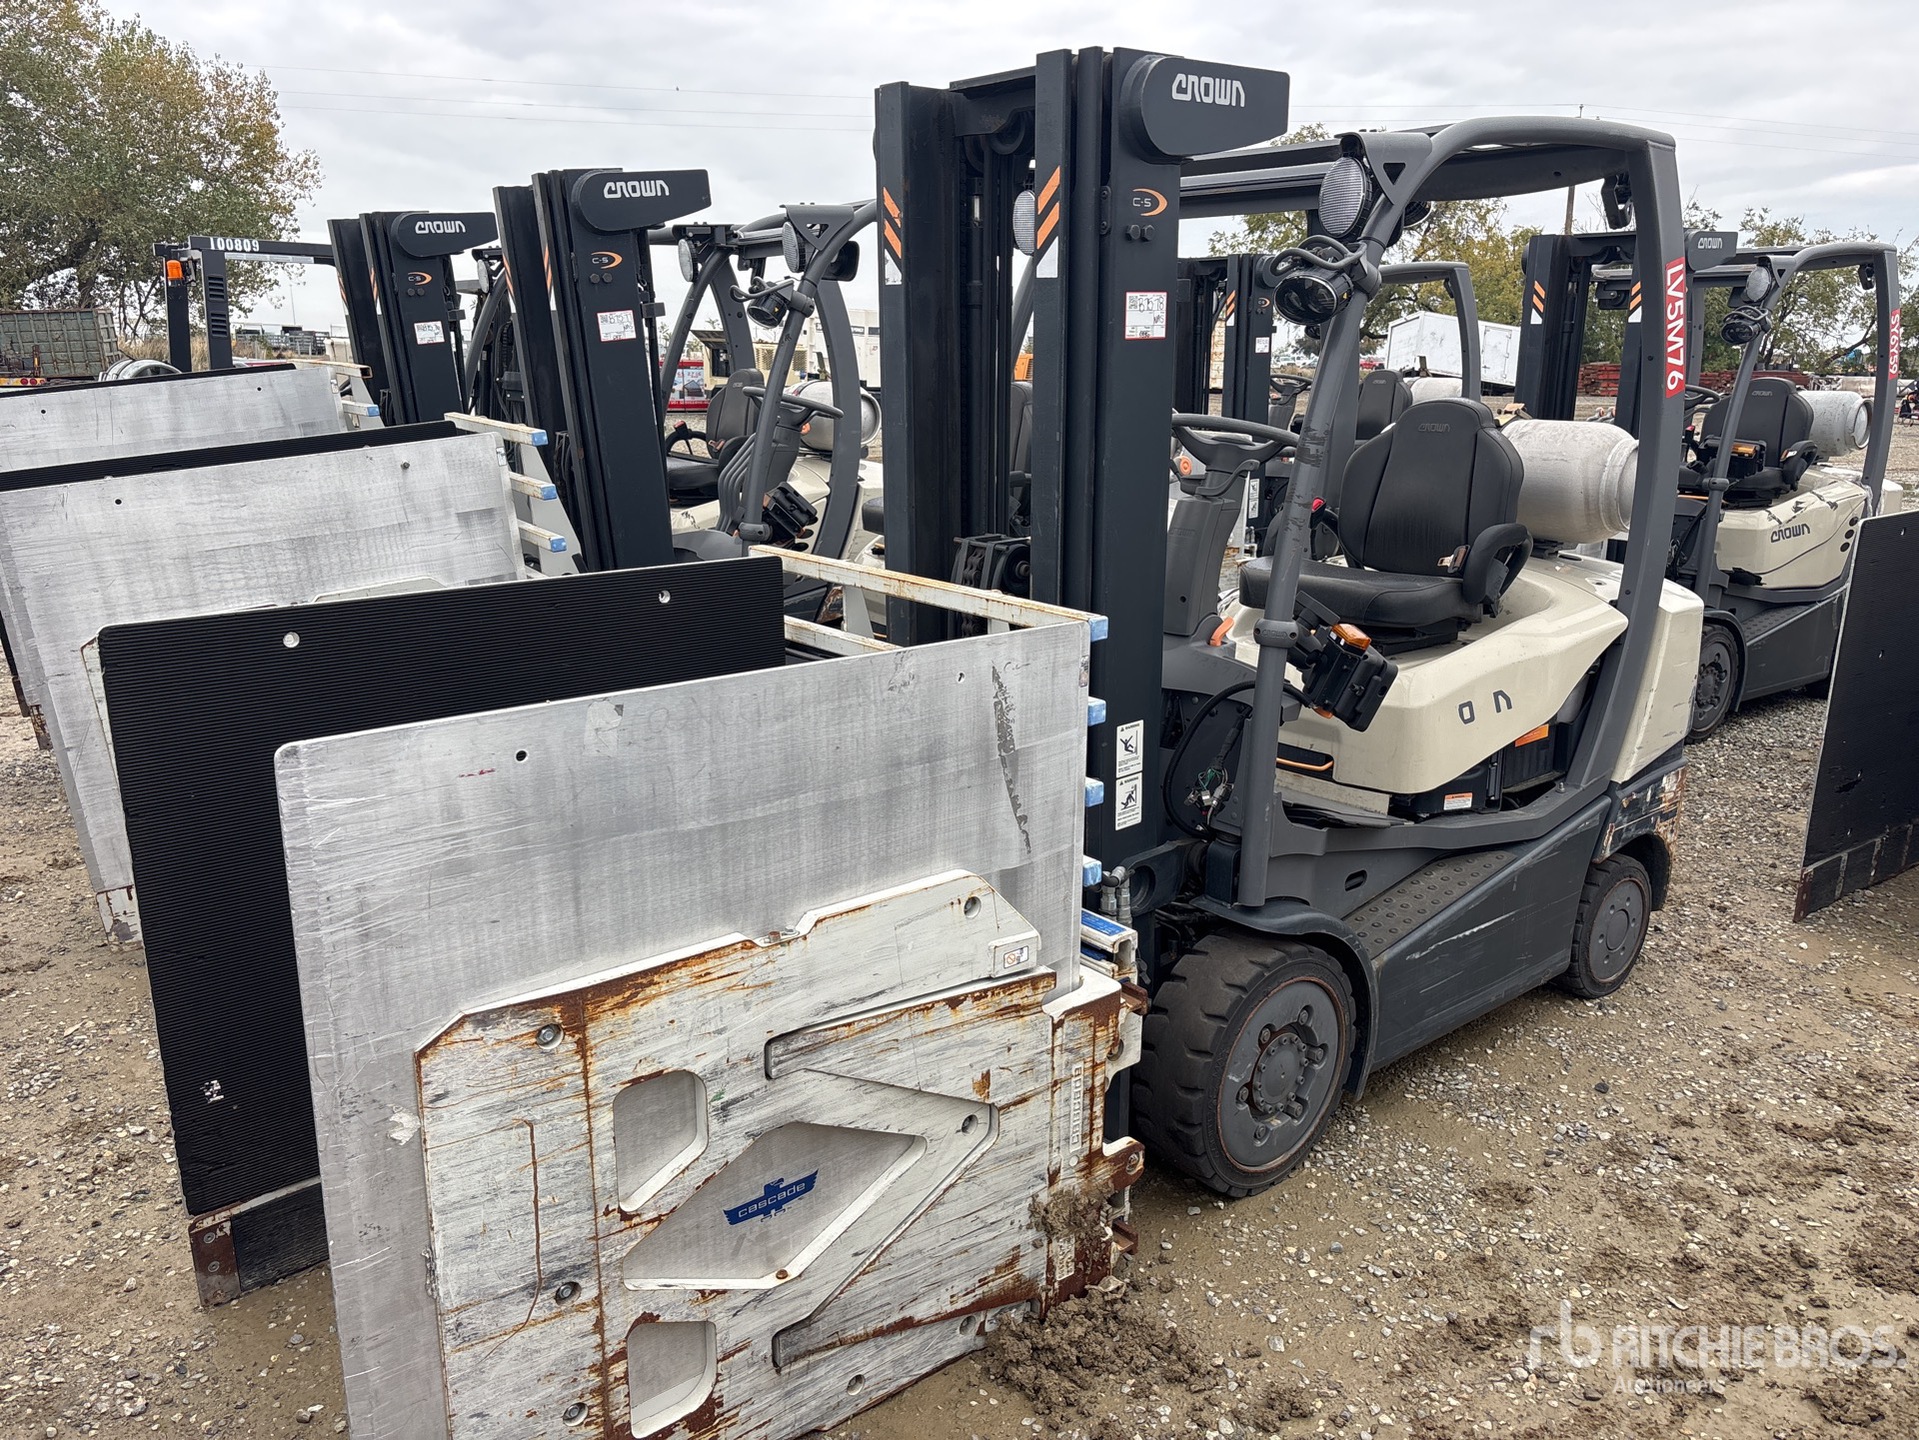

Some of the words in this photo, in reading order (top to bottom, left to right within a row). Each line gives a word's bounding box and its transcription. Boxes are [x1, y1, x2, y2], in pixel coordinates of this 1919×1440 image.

[1172, 73, 1246, 108] CROWN
[603, 180, 670, 199] CROWN
[415, 220, 466, 234] CROWN
[209, 236, 260, 252] 100809
[1697, 237, 1723, 249] CROWN
[1666, 263, 1684, 391] LV5M76
[1889, 313, 1900, 375] SY6Y59
[1770, 523, 1811, 543] CROWN
[738, 1182, 806, 1218] cascade
